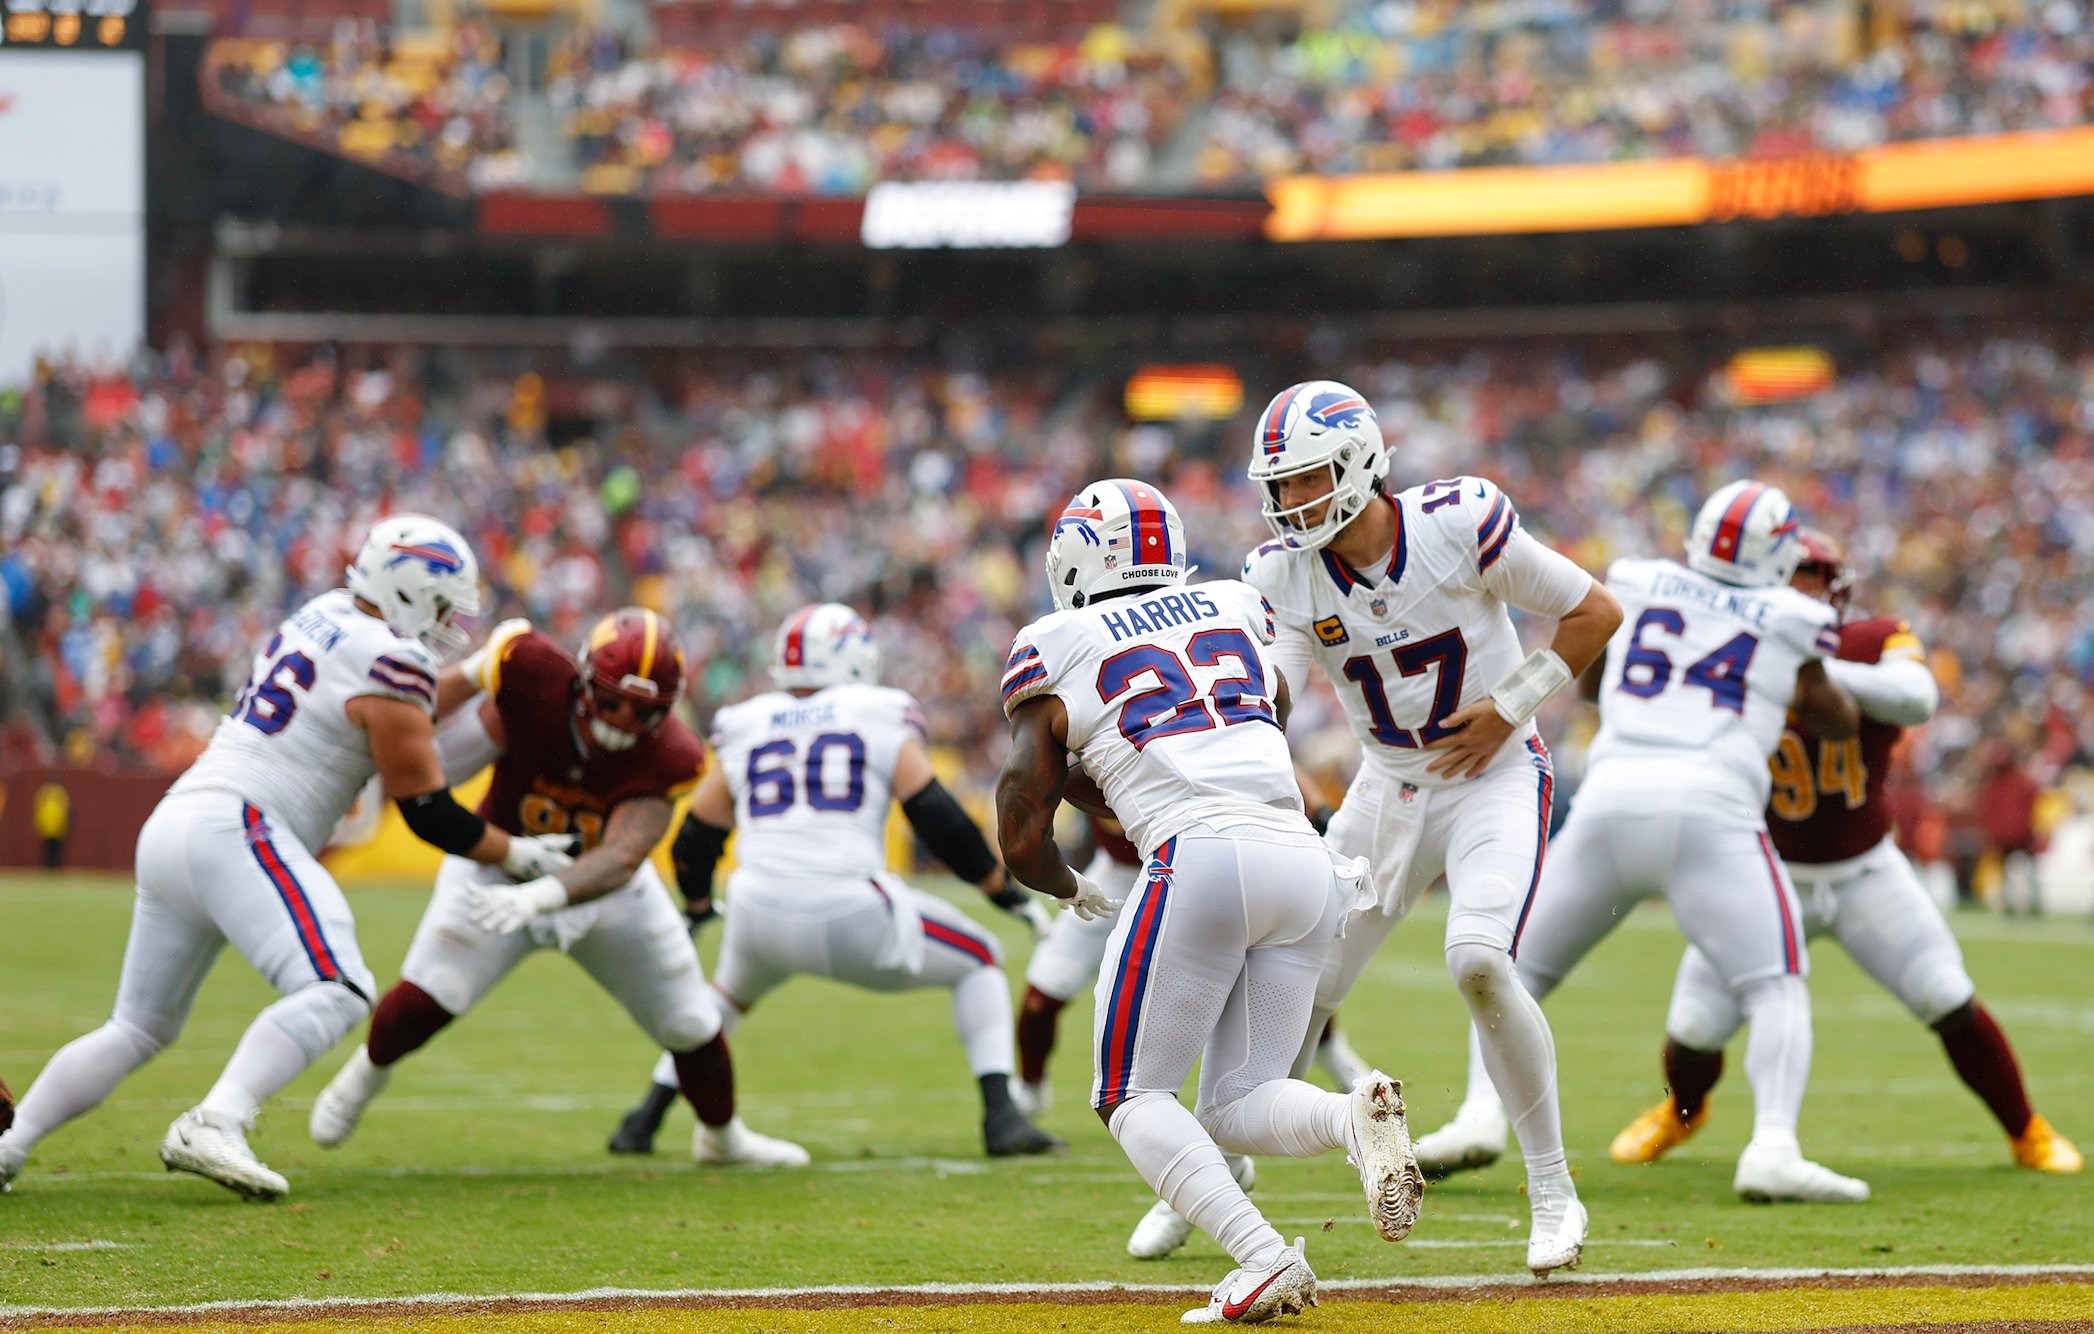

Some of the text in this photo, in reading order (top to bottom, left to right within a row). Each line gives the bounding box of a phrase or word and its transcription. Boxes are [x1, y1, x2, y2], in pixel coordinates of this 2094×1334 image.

[1100, 591, 1219, 642] HARRIS
[1122, 569, 1178, 580] CHOOSE LOVE
[1314, 618, 1344, 641] C
[1375, 629, 1409, 647] BILLS
[1616, 607, 1758, 716] 64
[1096, 628, 1284, 753] 22
[1343, 626, 1468, 749] 17
[749, 733, 865, 820] 60
[1768, 730, 1868, 821] 94
